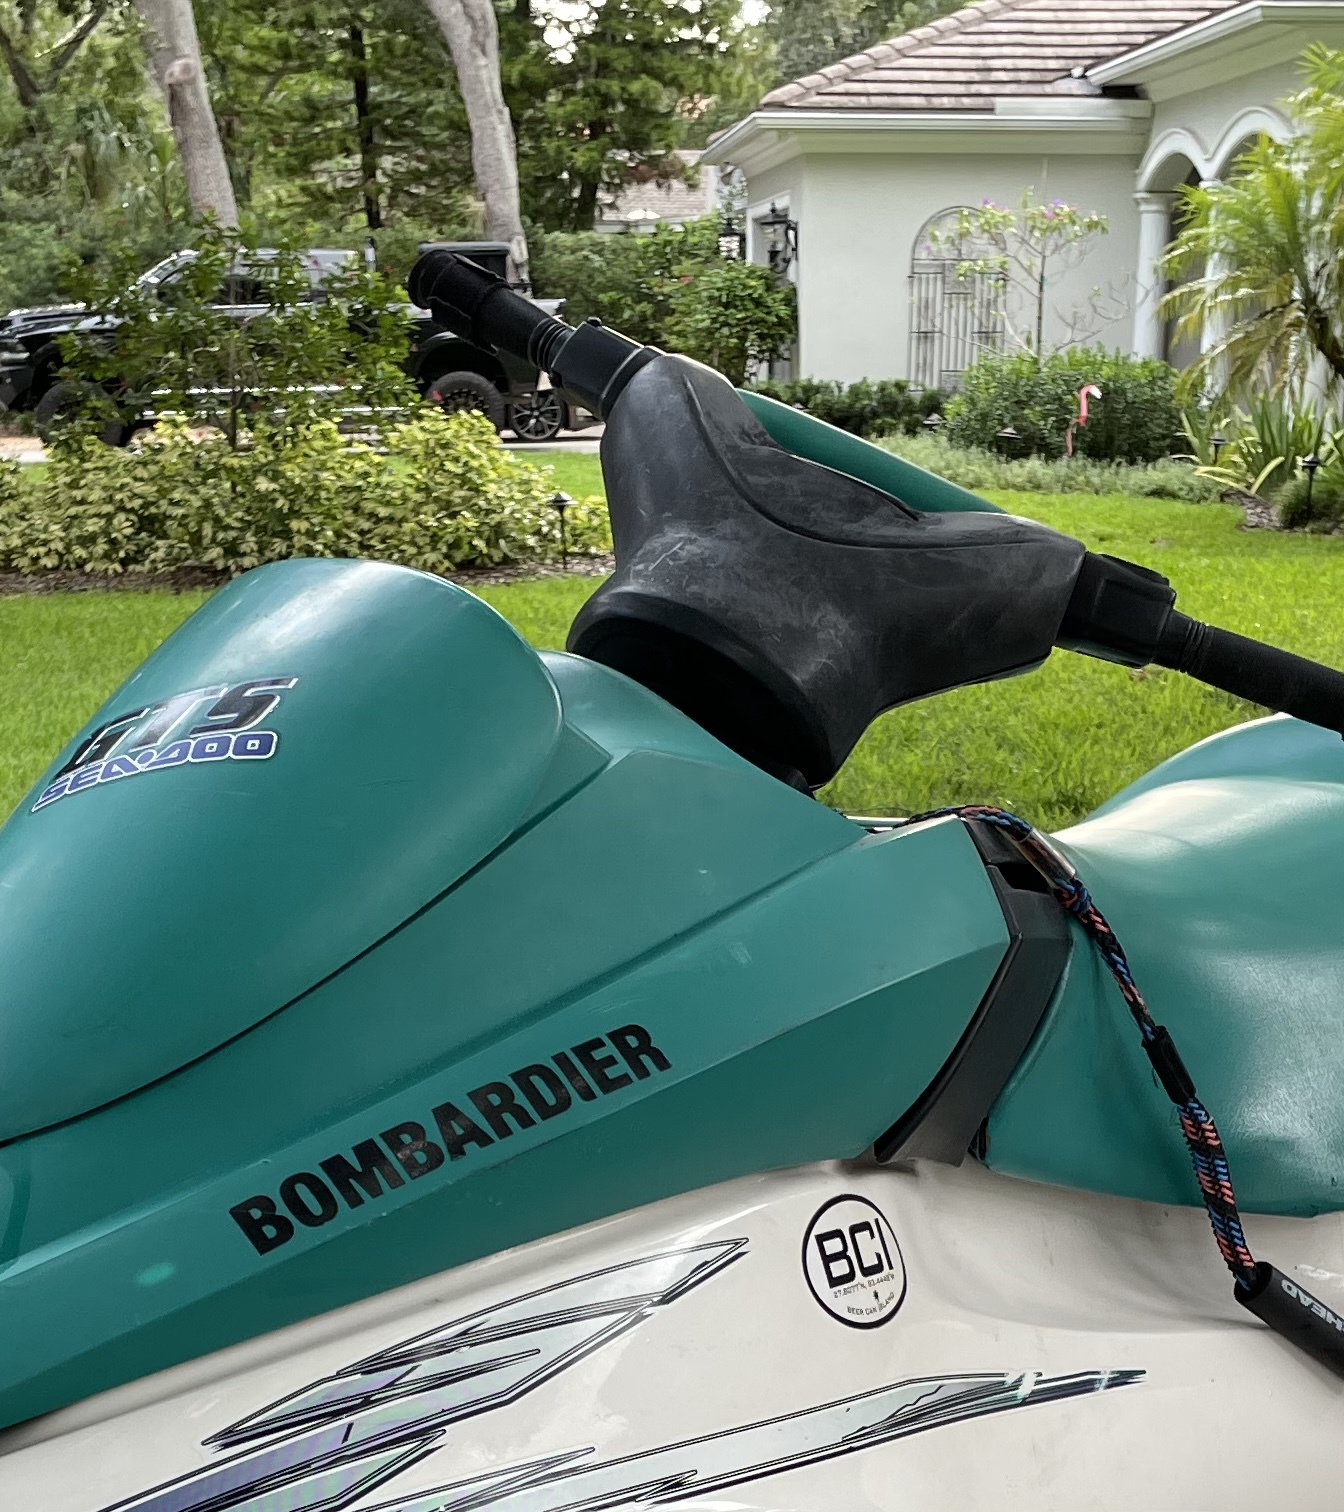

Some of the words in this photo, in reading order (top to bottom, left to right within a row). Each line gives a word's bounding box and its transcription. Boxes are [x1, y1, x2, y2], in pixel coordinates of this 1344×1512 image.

[49, 677, 298, 785] GTS
[229, 1023, 673, 1256] BOMBARDIER
[814, 1218, 894, 1289] BCI
